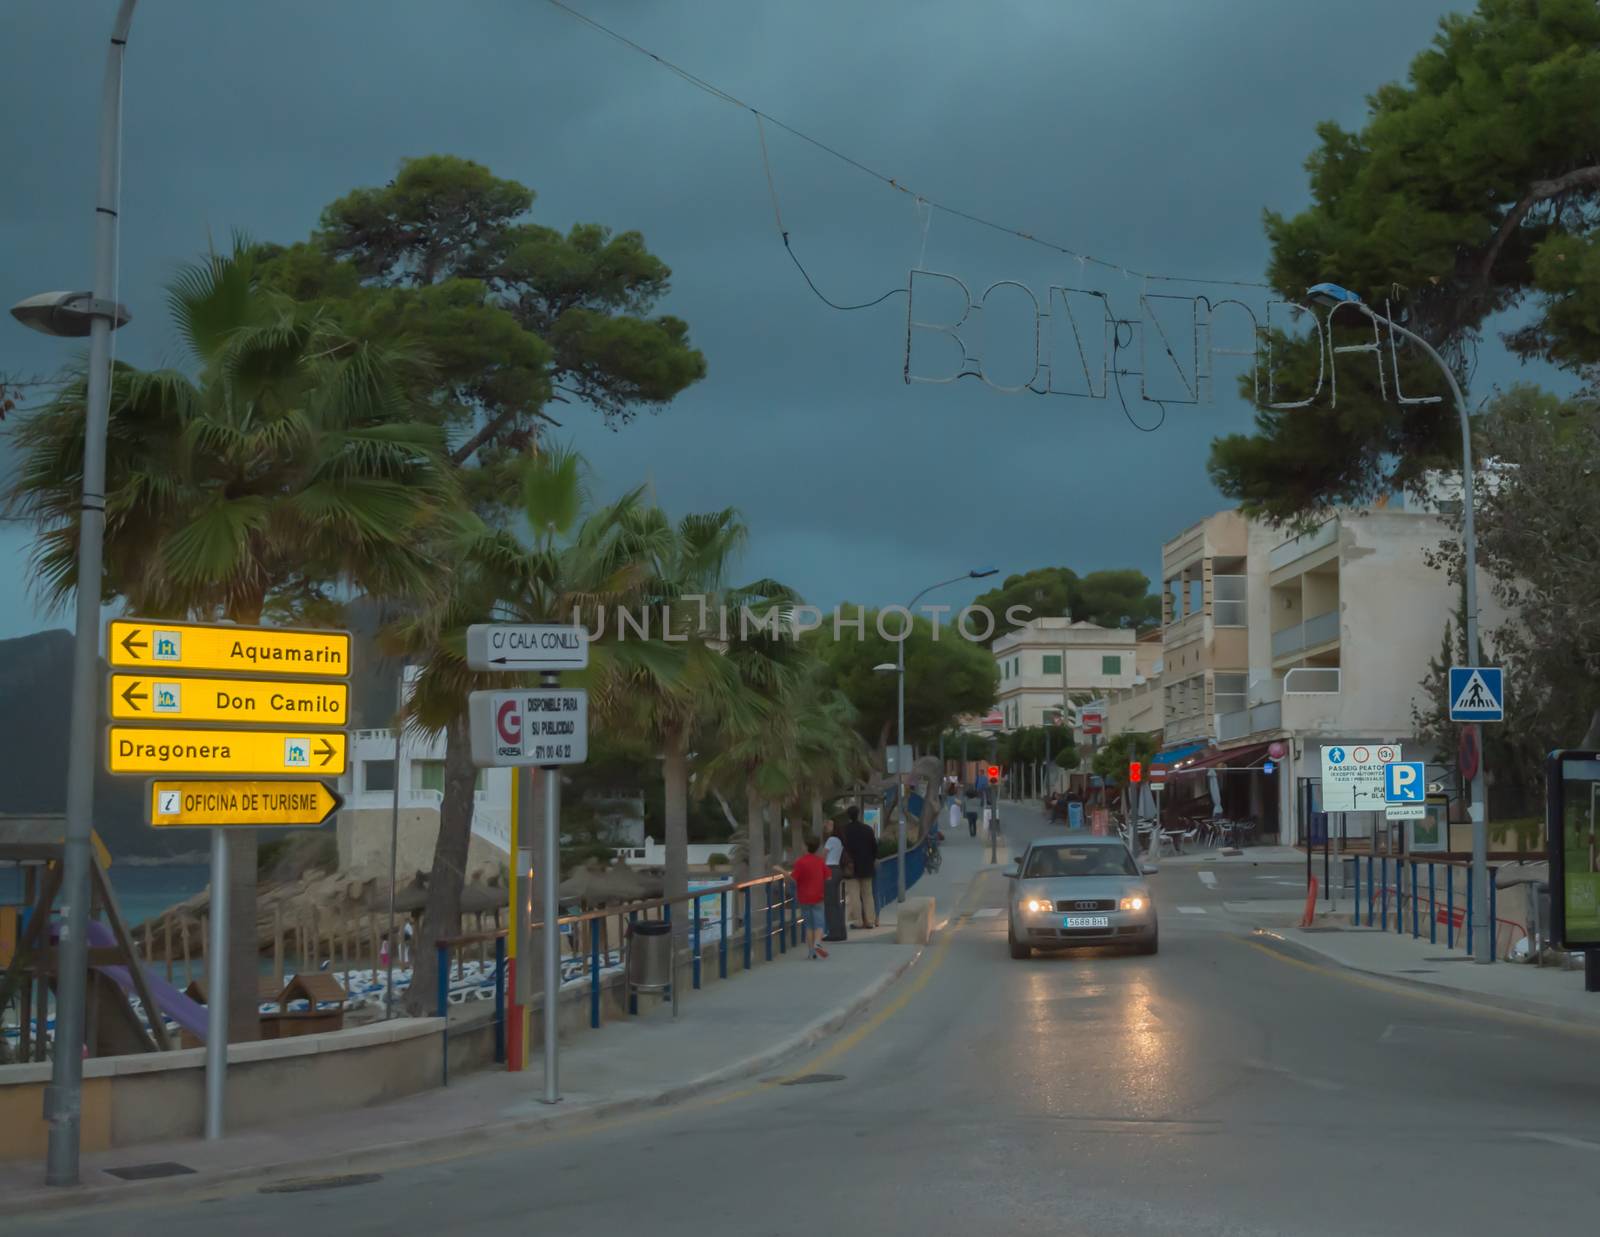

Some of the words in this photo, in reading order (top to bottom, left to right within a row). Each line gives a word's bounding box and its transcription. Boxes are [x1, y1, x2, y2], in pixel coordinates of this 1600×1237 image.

[492, 632, 506, 649] C/
[509, 632, 538, 649] CALA
[229, 641, 342, 664] Aquamarin
[216, 692, 256, 710] Don
[270, 694, 340, 713] Camilo
[562, 697, 578, 712] PARA
[531, 721, 540, 735] SU
[541, 720, 575, 735] PUBLICIDAD
[119, 740, 231, 762] Dragonera
[1392, 765, 1417, 795] P
[185, 794, 237, 811] OFICINA
[242, 794, 259, 811] DE
[262, 794, 317, 811] TURISME
[1069, 918, 1090, 926] 5688
